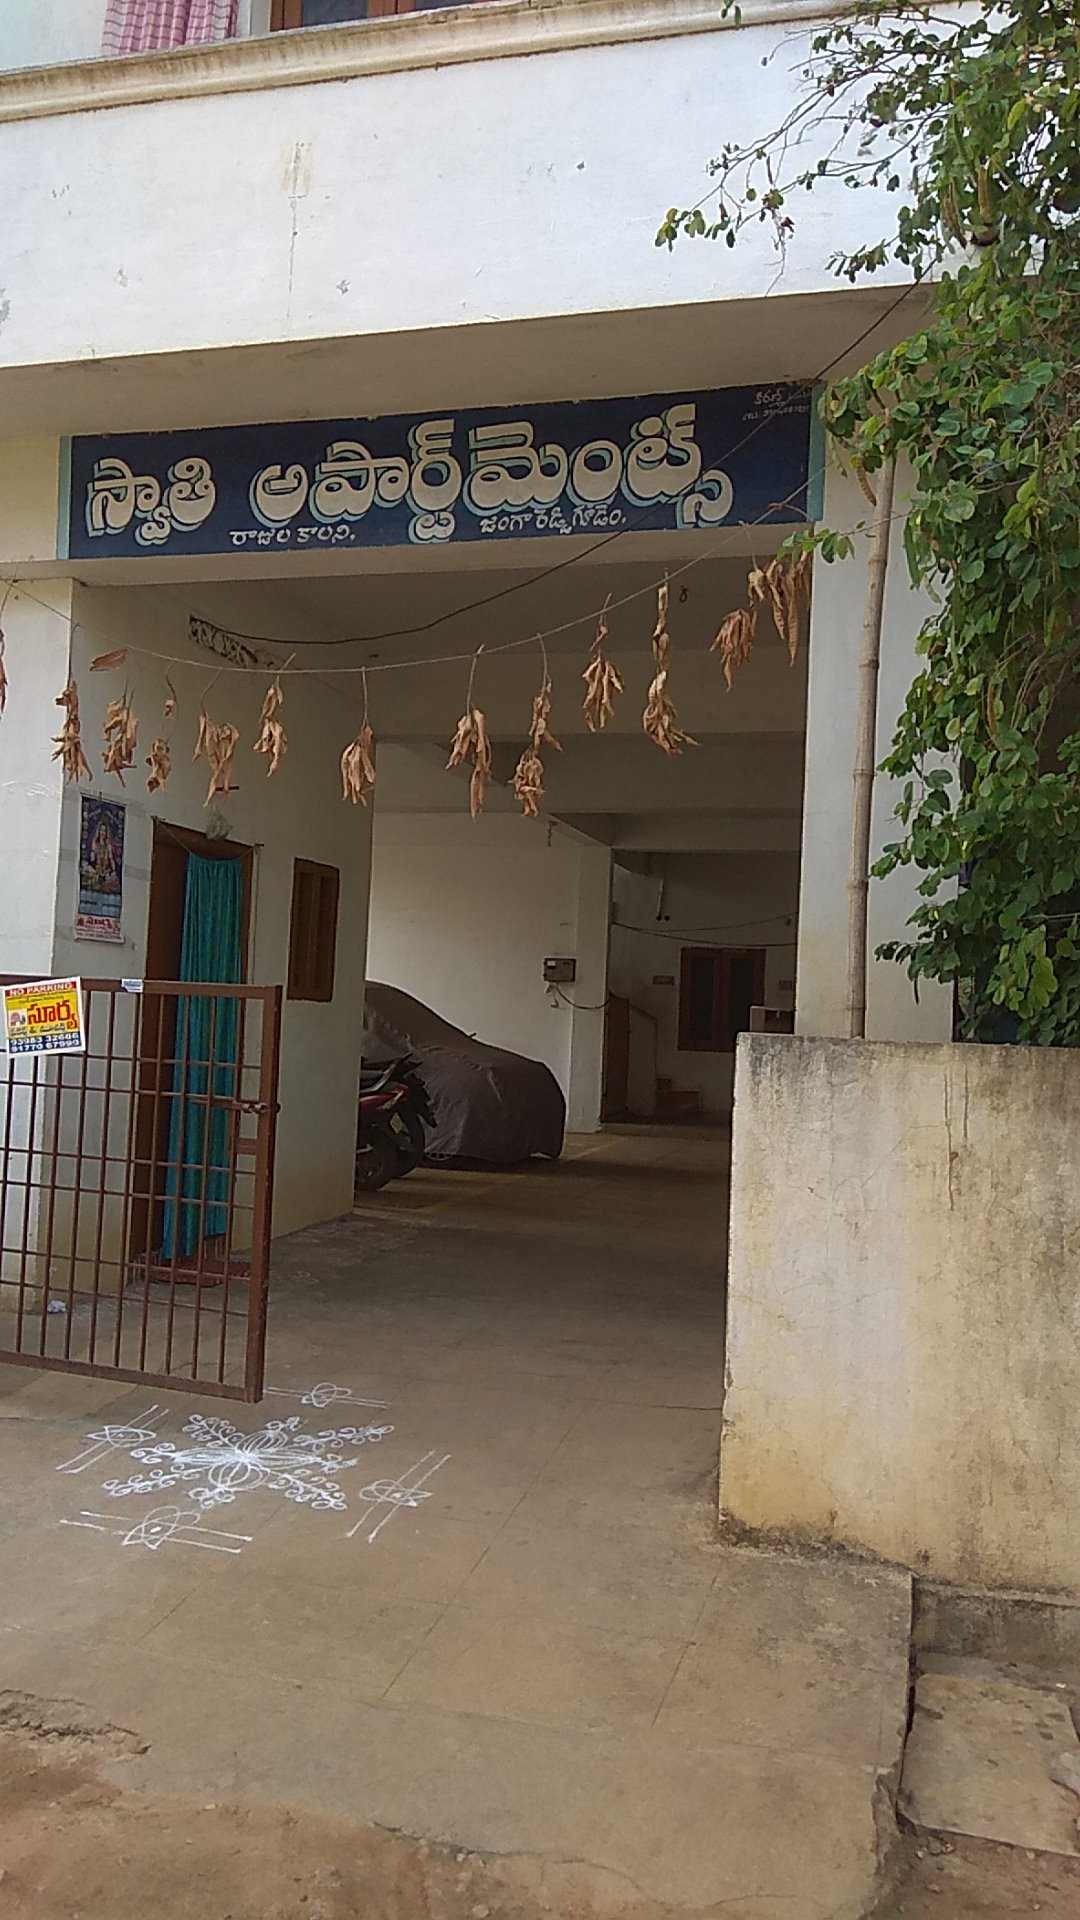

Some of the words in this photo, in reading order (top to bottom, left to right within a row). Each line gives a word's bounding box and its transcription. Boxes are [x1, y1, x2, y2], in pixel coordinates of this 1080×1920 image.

[86, 457, 216, 545] స్వాతి
[27, 982, 73, 994] PARKING
[27, 1000, 78, 1030] సూర్య
